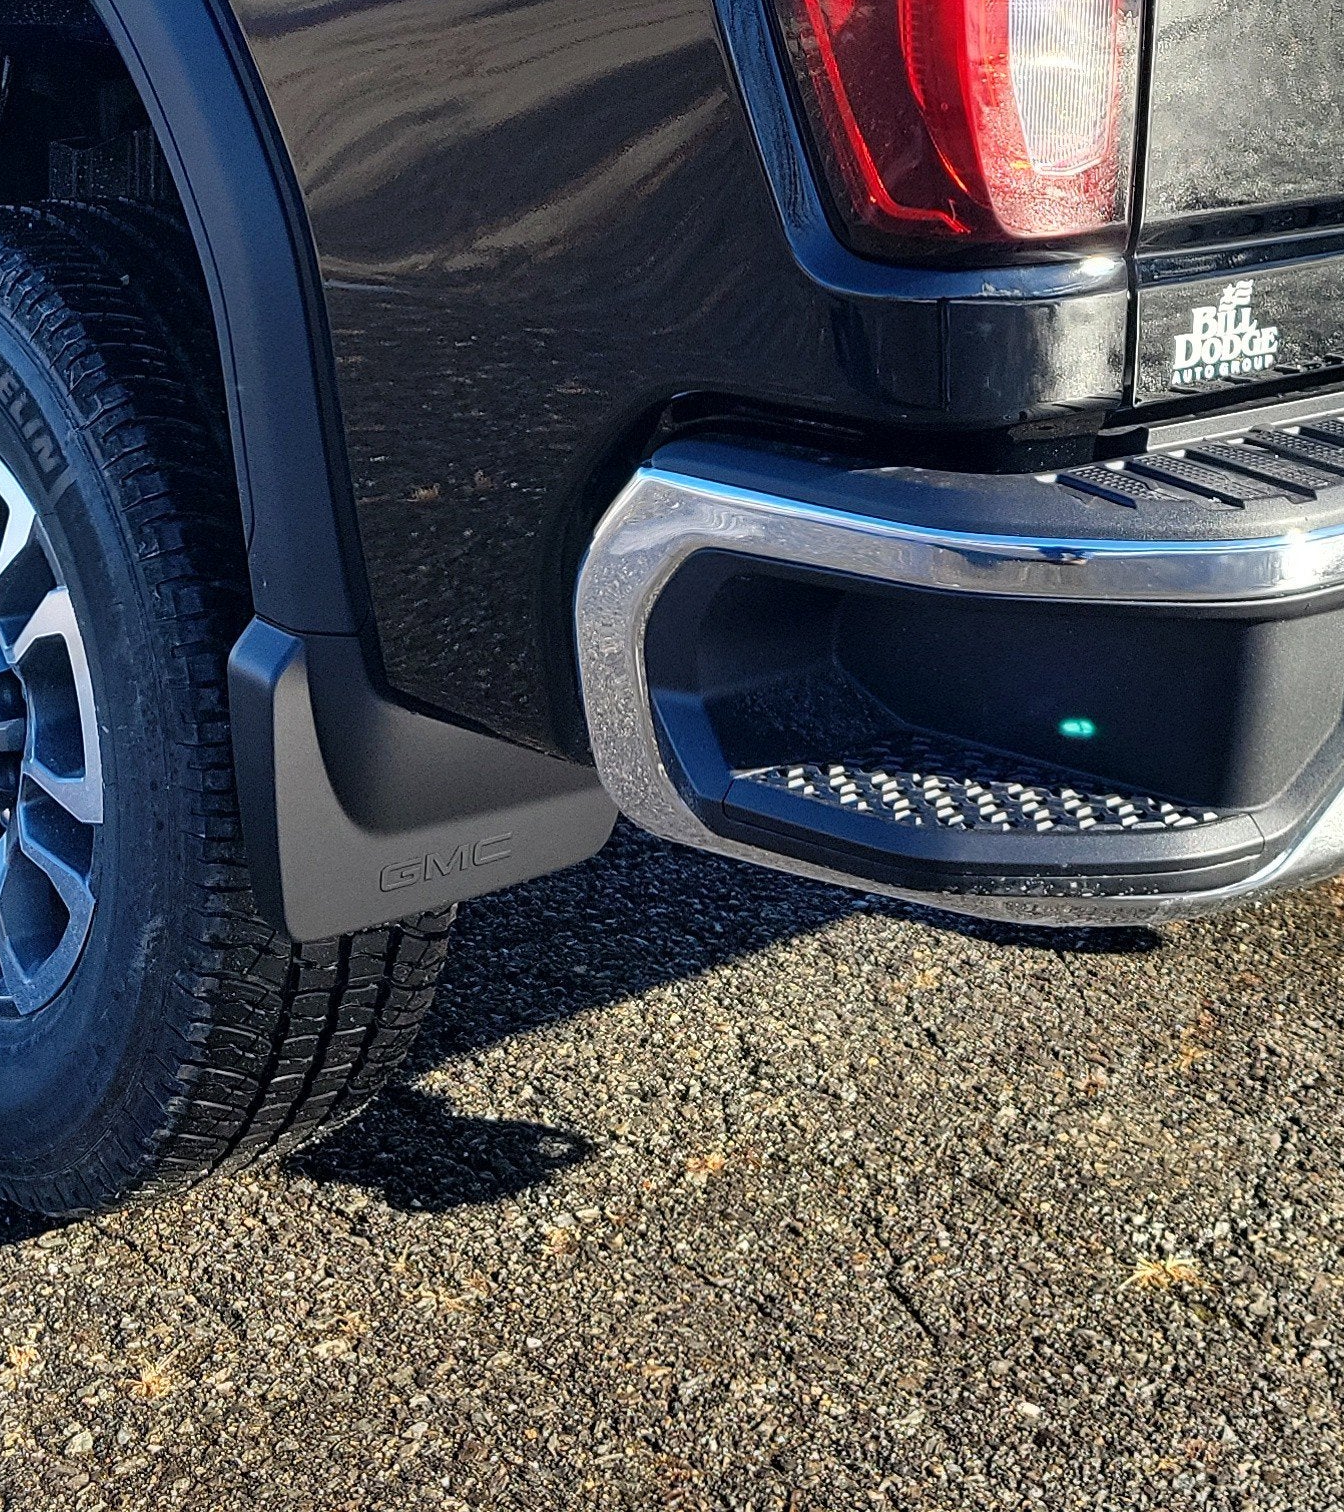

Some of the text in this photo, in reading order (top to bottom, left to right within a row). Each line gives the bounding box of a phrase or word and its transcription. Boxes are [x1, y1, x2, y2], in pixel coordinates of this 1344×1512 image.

[1192, 306, 1257, 338] BILL
[1173, 327, 1278, 370] DODGE
[1172, 354, 1275, 385] AUTO GROUP
[379, 832, 512, 893] GMC
